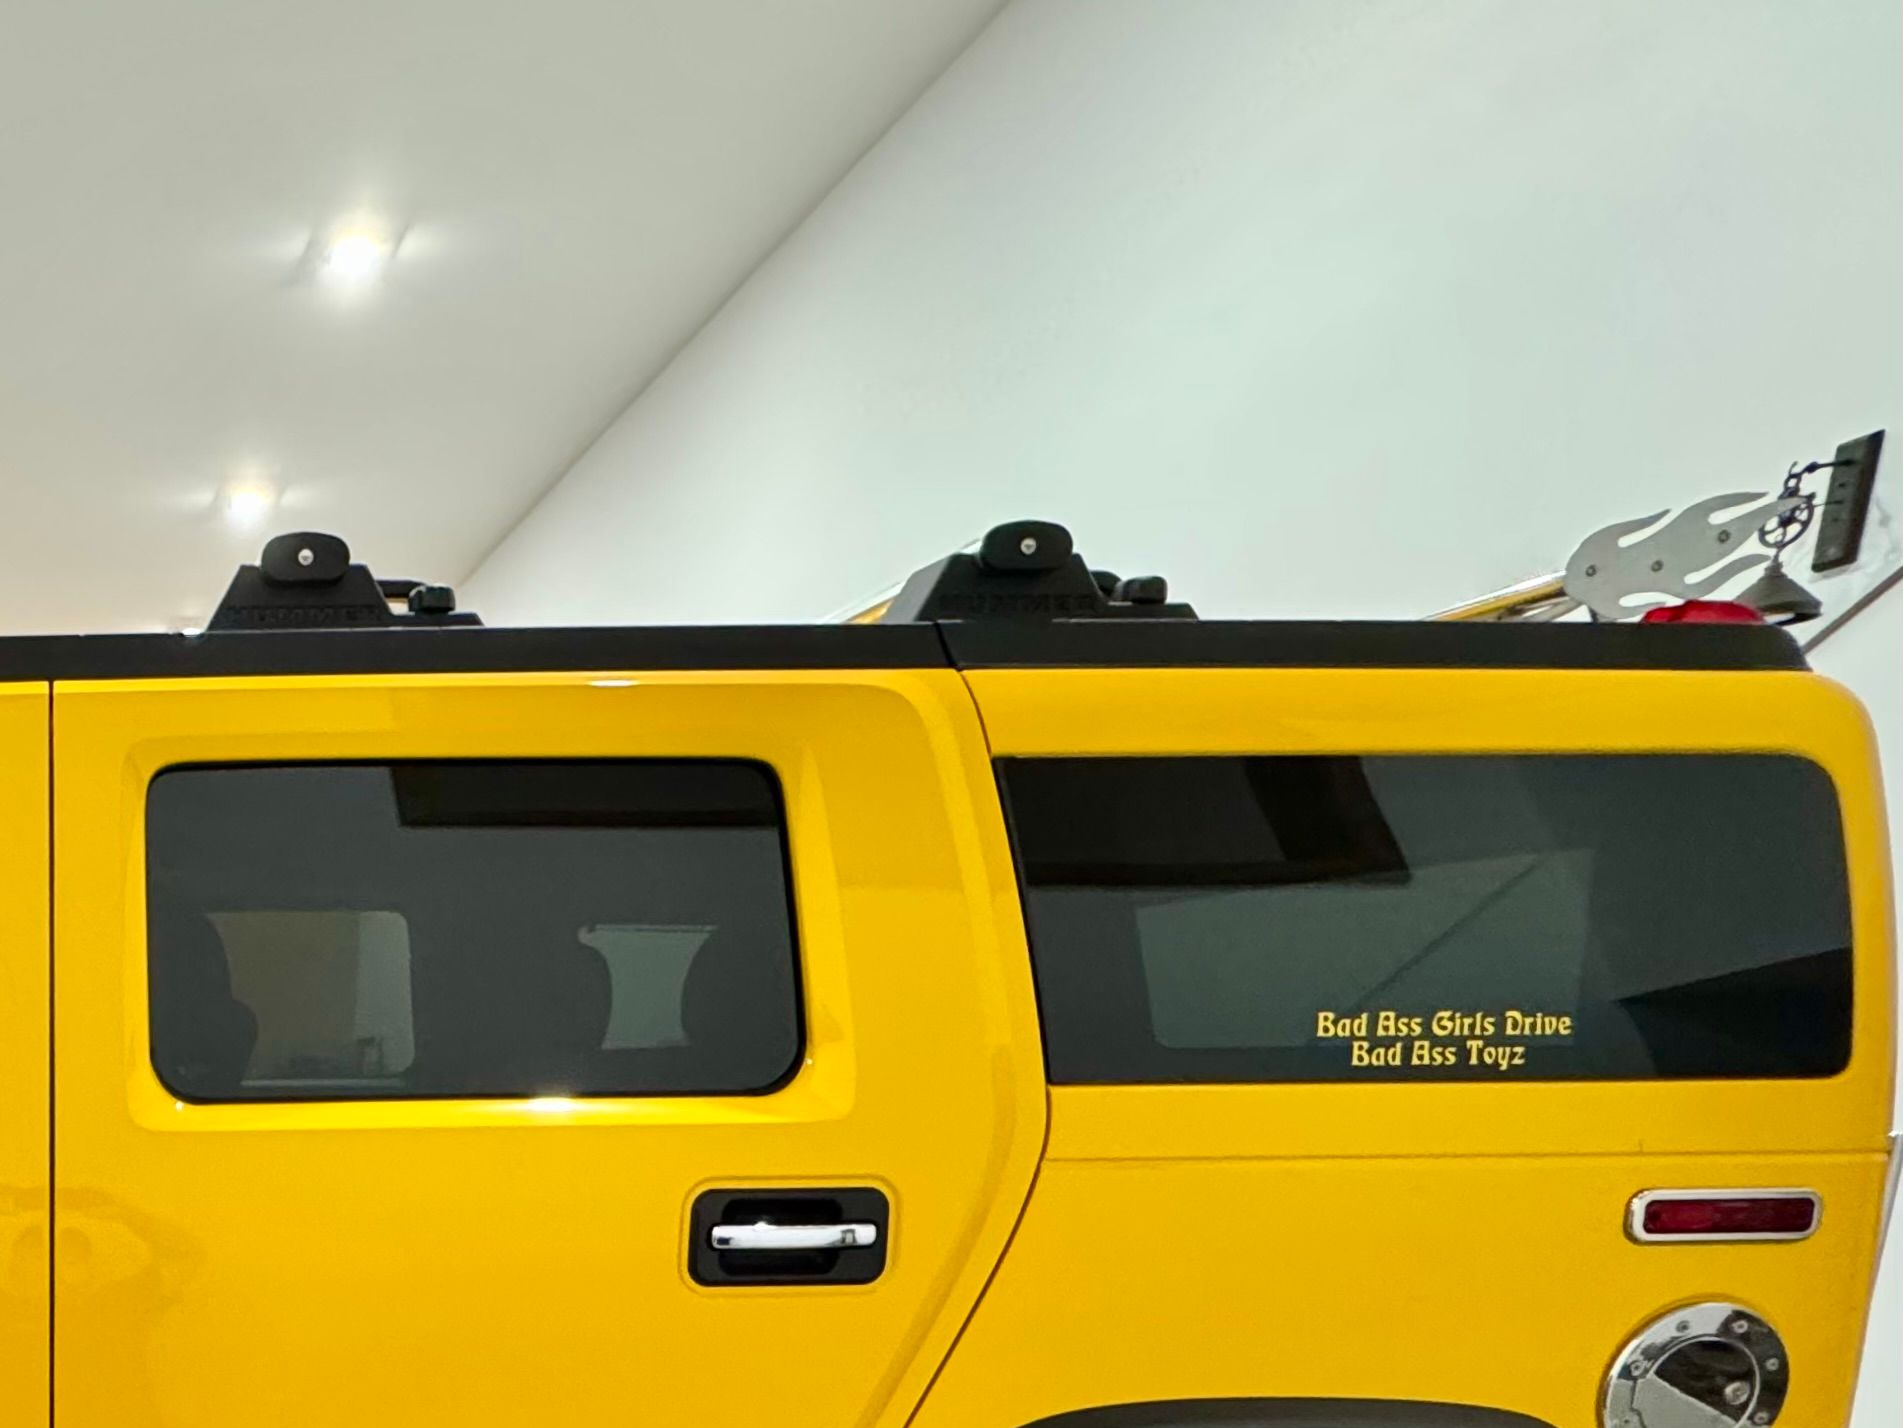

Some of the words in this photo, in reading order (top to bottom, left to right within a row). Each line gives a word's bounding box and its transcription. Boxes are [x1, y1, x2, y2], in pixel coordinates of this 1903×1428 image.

[1316, 1011, 1368, 1037] Bad
[1377, 1011, 1423, 1036] Ass
[1431, 1010, 1495, 1036] Girls
[1504, 1010, 1572, 1036] Drive
[1351, 1040, 1402, 1066] Bad
[1411, 1040, 1456, 1066] Ass
[1466, 1040, 1525, 1070] Toyz
